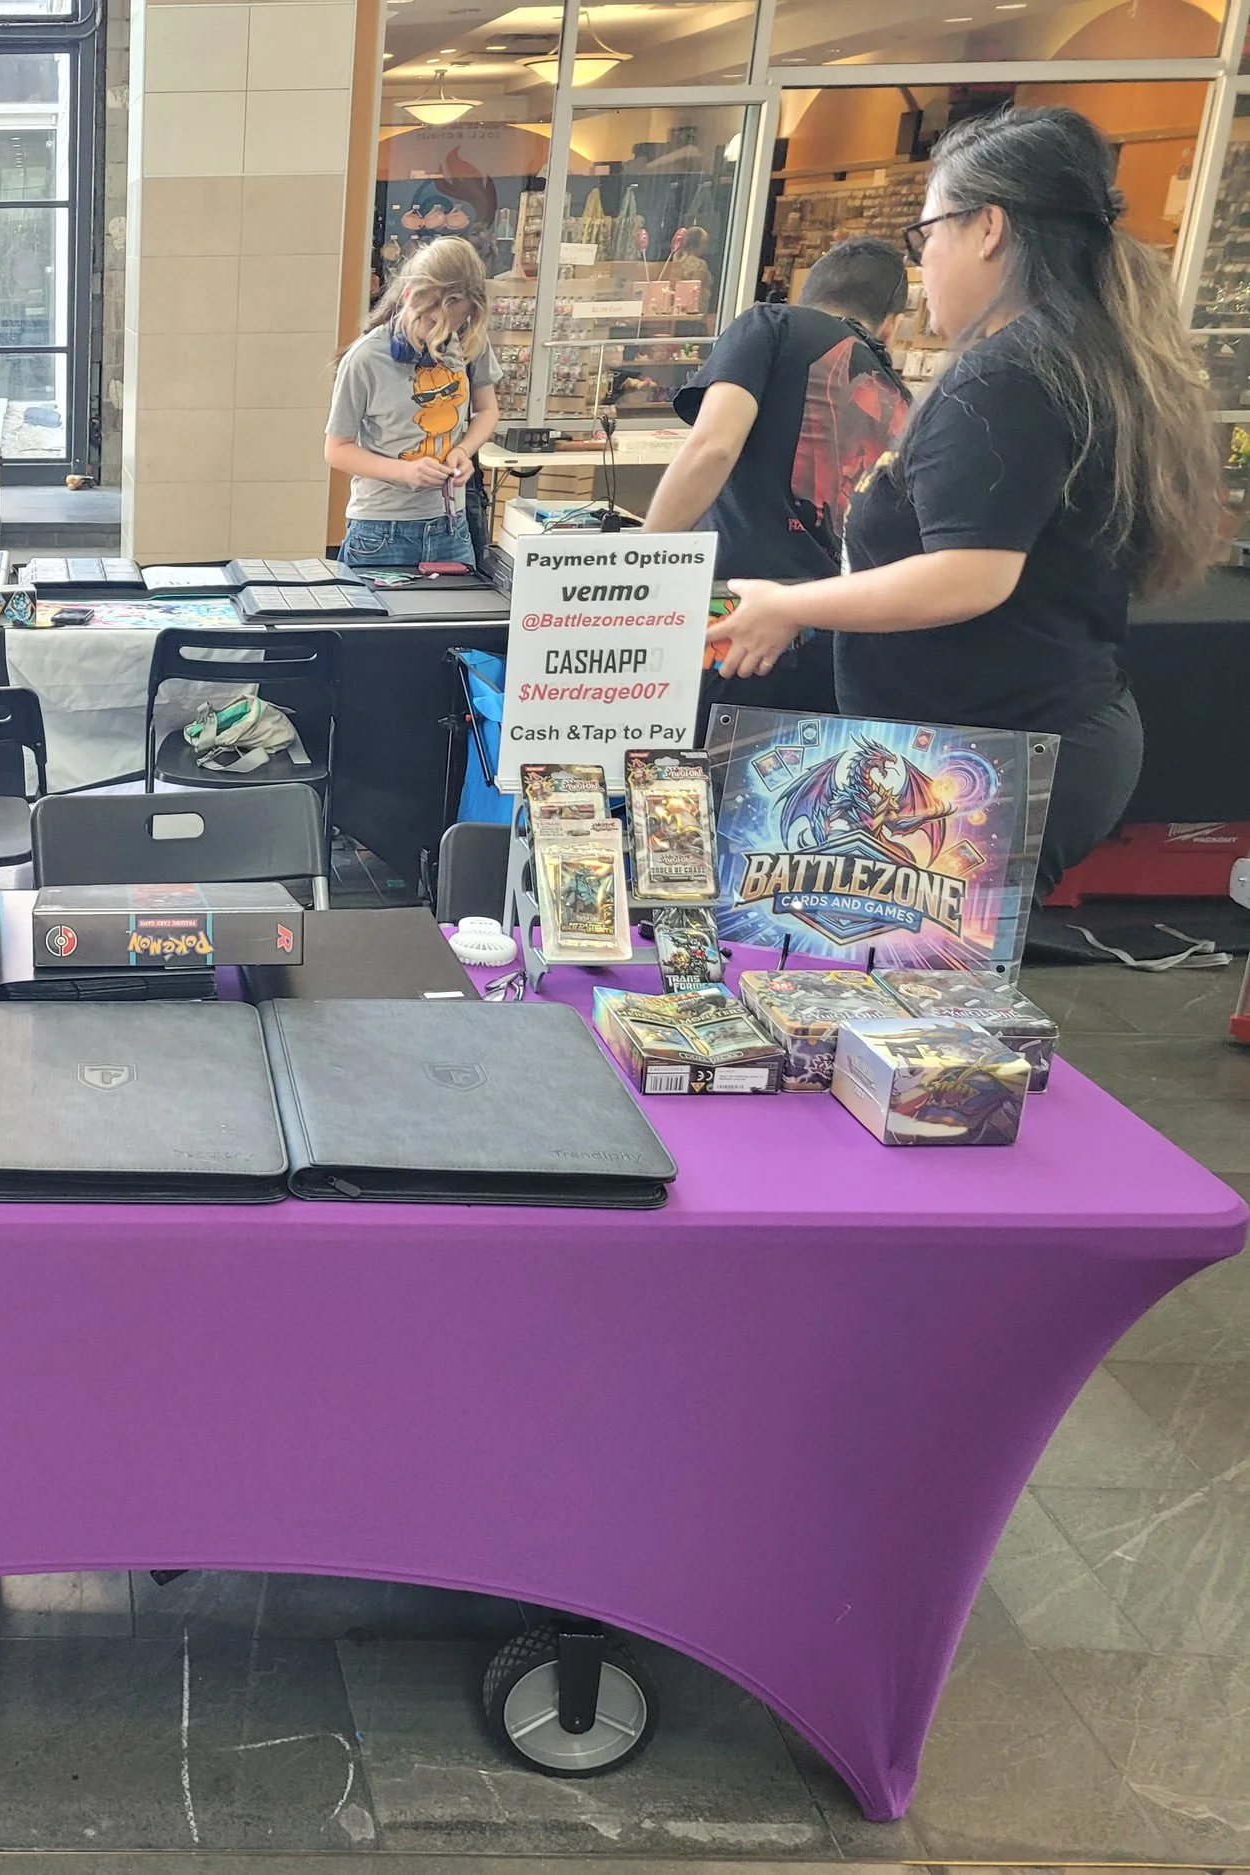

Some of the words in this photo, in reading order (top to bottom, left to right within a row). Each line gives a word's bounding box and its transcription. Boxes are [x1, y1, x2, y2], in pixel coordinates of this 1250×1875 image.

[526, 552, 617, 570] Payment
[624, 550, 705, 569] Options
[562, 584, 650, 602] venmo
[521, 612, 686, 632] @Battlezonecards
[545, 649, 647, 674] CASHAPP
[518, 682, 670, 704] $Nerdrage007
[510, 725, 559, 741] Cash
[566, 724, 617, 744] &Tap
[623, 725, 643, 740] to
[649, 724, 686, 743] Pay
[741, 853, 963, 932] BATTLEZONE
[781, 895, 827, 908] CARDS
[832, 897, 860, 910] AND
[864, 902, 915, 924] GAMES
[665, 974, 700, 987] TRANS
